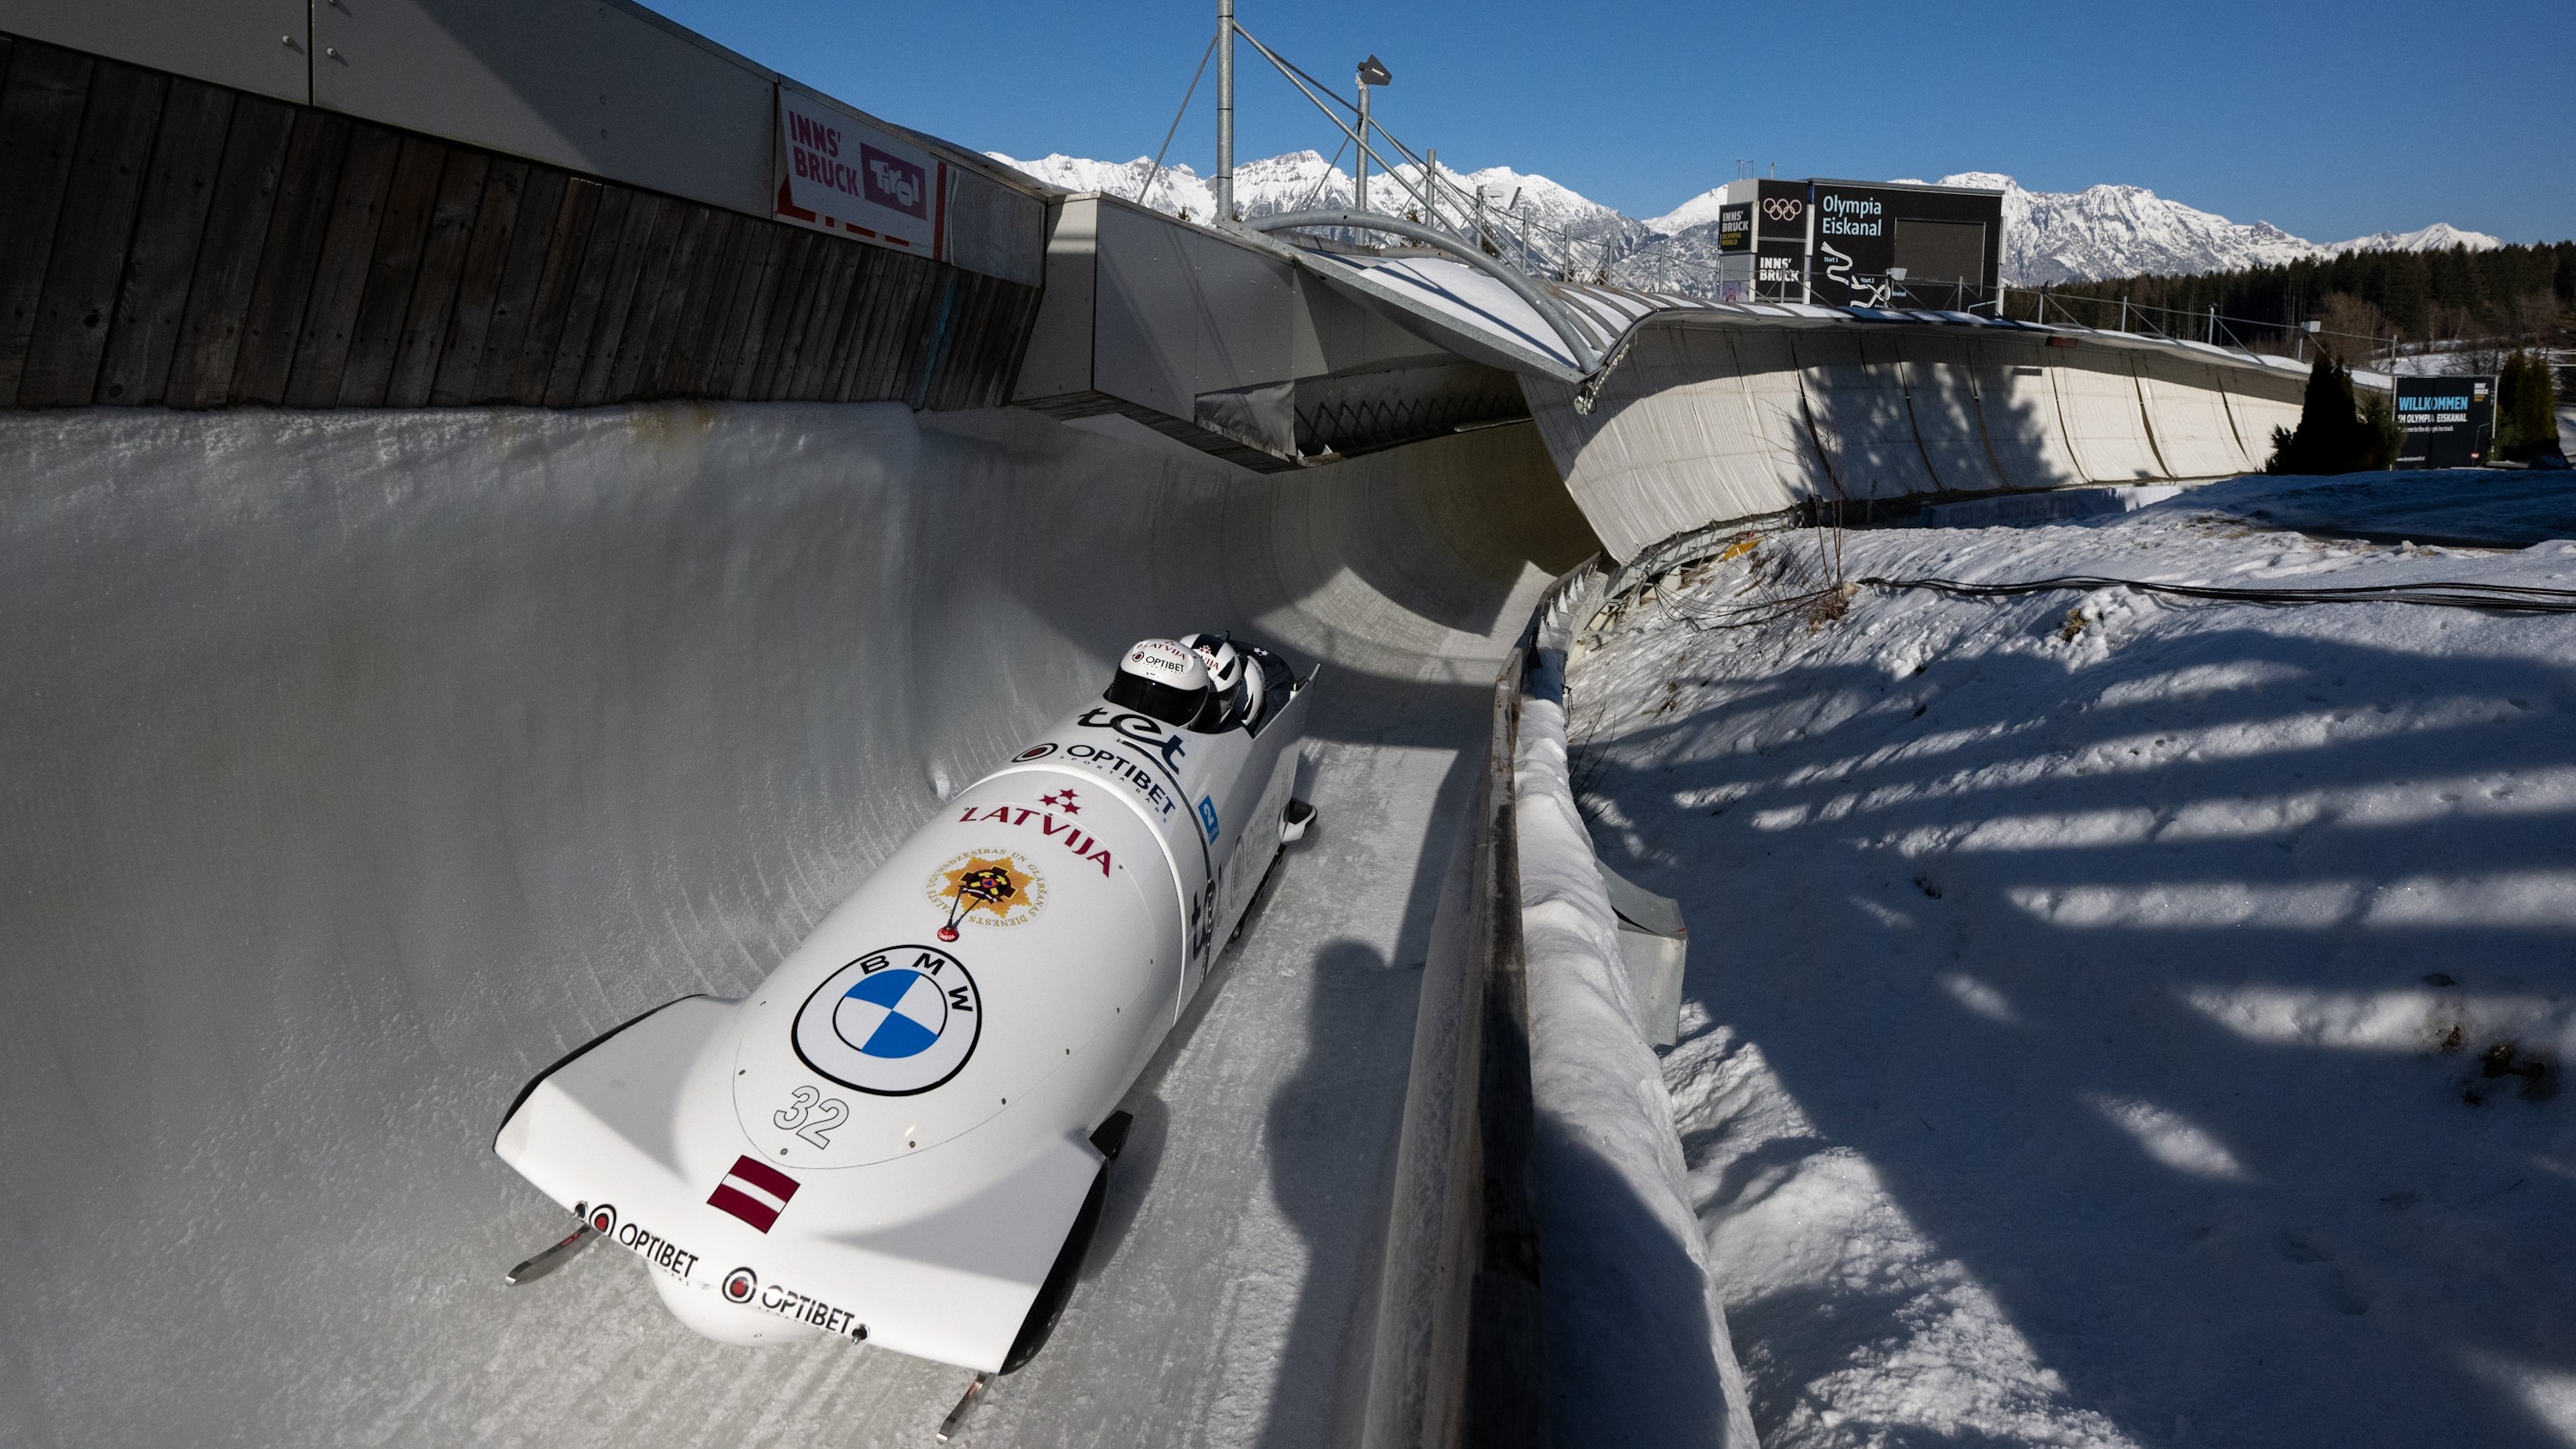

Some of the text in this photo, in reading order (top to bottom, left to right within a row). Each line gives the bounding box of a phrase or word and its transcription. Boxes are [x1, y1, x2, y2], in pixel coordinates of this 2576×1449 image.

[789, 110, 841, 158] INNS'
[793, 145, 860, 197] BRUCK
[870, 159, 920, 207] Tirol
[1823, 194, 1881, 219] Olympia
[1722, 221, 1749, 233] BRUCK
[1822, 216, 1882, 236] Eiskanal
[1759, 257, 1792, 270] INNS'
[1759, 269, 1799, 282] BRUCK
[2398, 396, 2469, 411] WILLKOMMEN
[2406, 413, 2435, 423] OLYMPIA
[2436, 413, 2467, 423] EISKANAL
[1145, 655, 1185, 673] OPTIBET
[1077, 707, 1186, 775] tet
[1059, 755, 1126, 782] SPORTA
[1066, 745, 1176, 815] OPTIBET
[1203, 803, 1215, 827] 2
[958, 806, 1112, 879] LATVIJA
[1011, 851, 1028, 863] UN
[969, 914, 1029, 928] DIENESTS
[860, 952, 974, 1013] BMW
[773, 1085, 850, 1151] 32
[619, 1222, 700, 1279] OPTIBET
[762, 1284, 856, 1336] OPTIBET
